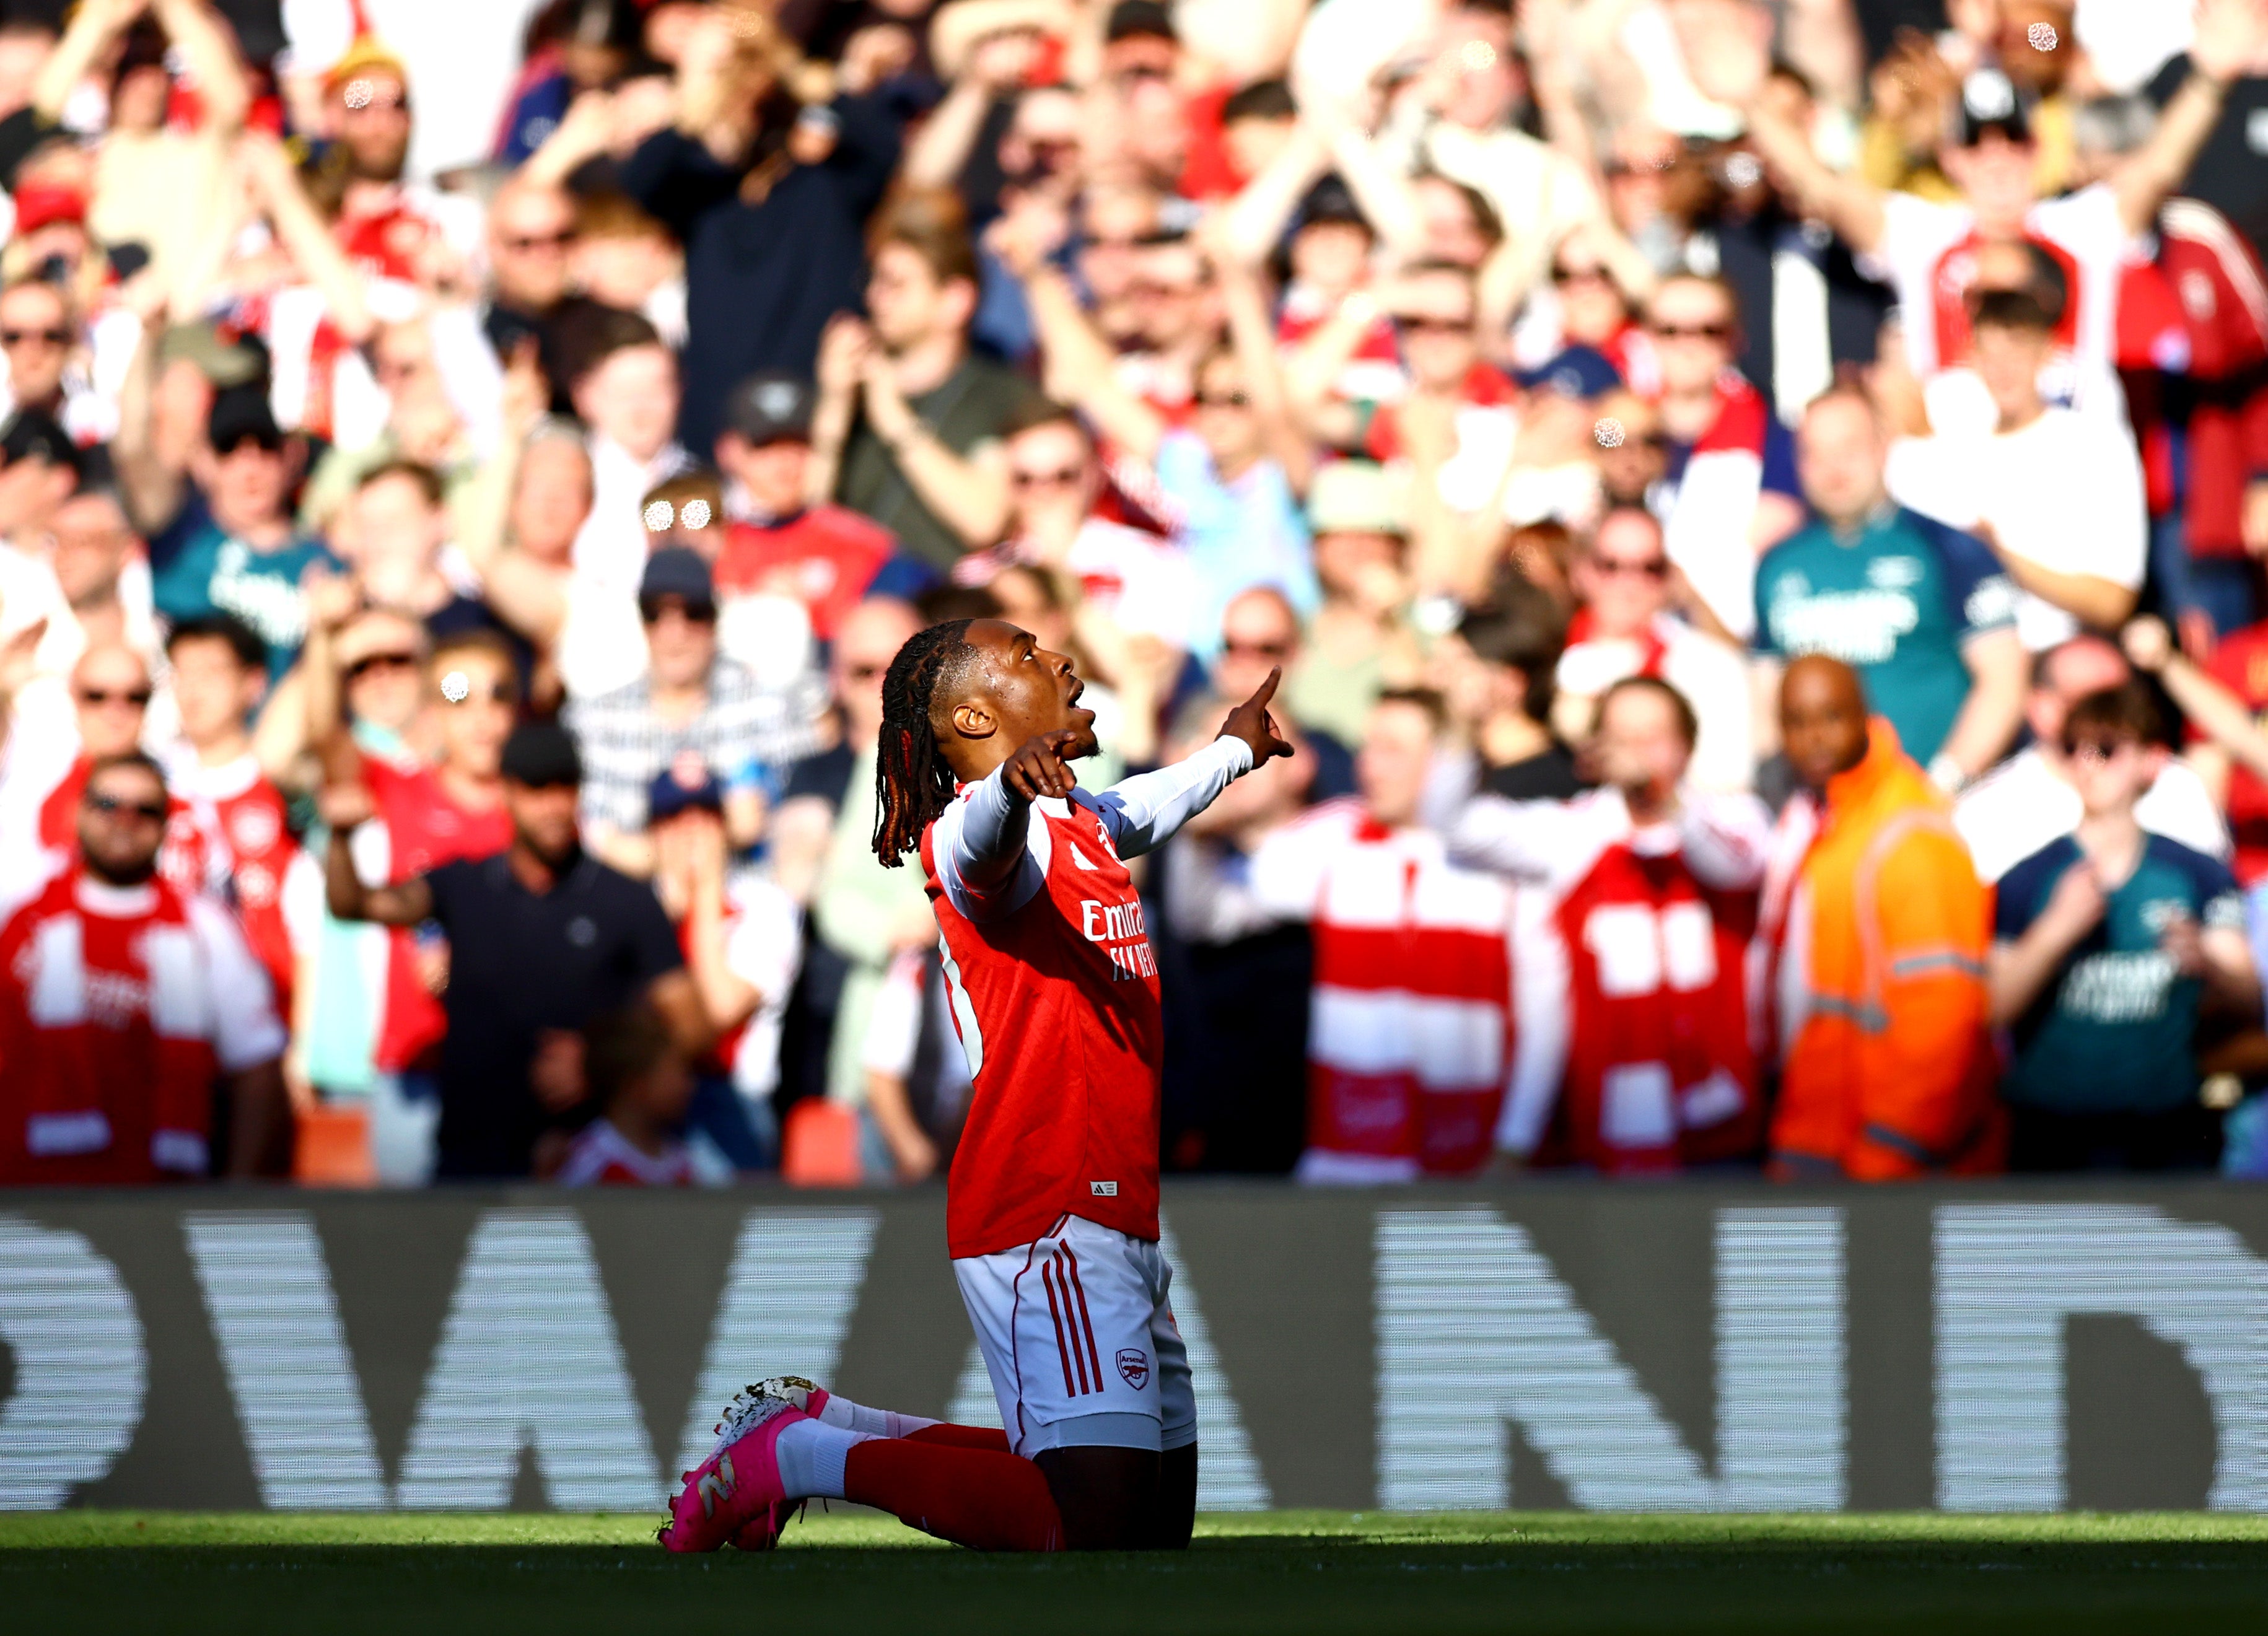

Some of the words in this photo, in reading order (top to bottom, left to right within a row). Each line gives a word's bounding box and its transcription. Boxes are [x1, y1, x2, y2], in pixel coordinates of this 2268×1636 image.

[1080, 895, 1145, 942] Emira
[1110, 945, 1137, 981] FLY
[1121, 1355, 1145, 1364] Arsenal
